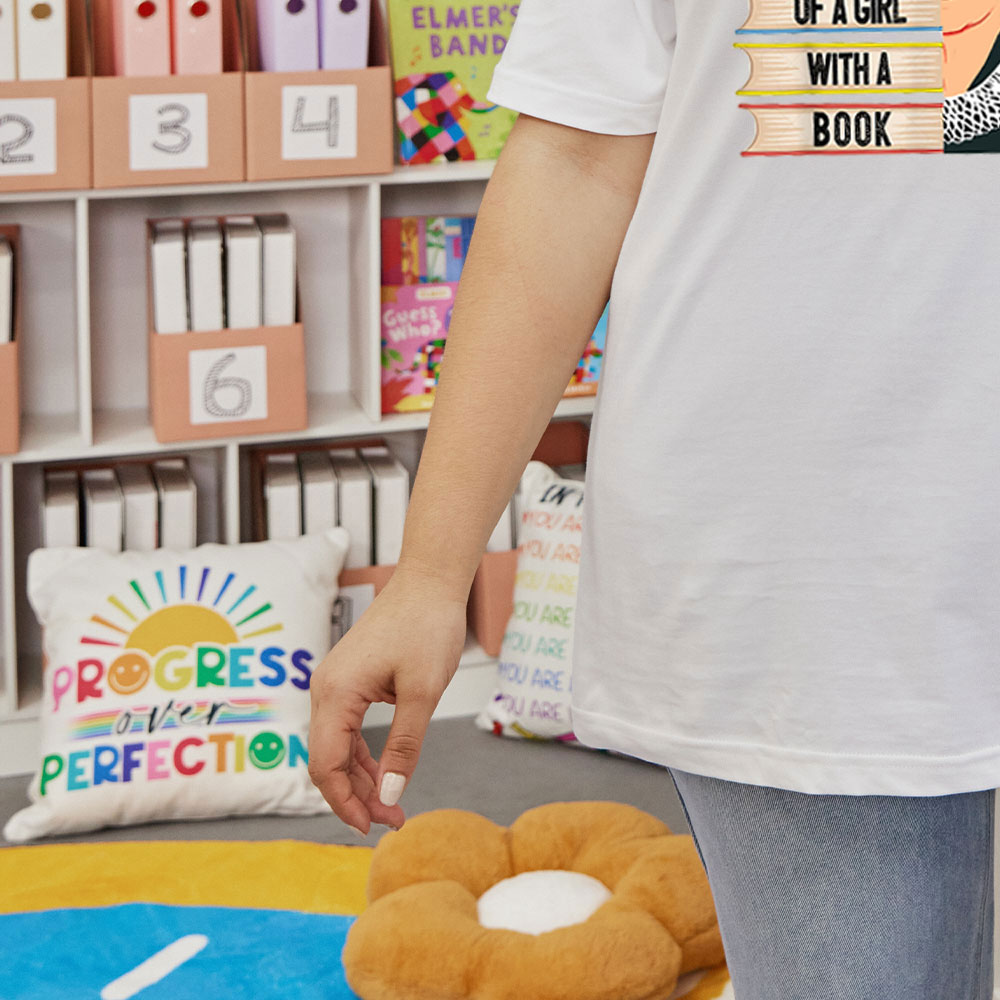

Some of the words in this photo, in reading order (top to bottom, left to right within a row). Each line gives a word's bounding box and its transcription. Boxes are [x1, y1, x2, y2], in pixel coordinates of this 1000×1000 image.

[807, 52, 870, 86] WITH
[876, 52, 892, 85] A
[152, 103, 192, 154] 3
[291, 96, 339, 148] 4
[812, 111, 892, 147] BOOK
[383, 306, 437, 328] Guess
[203, 352, 252, 418] 6
[53, 646, 313, 712] PROGRESS
[116, 699, 234, 735] over
[40, 731, 309, 796] PERFECTION
